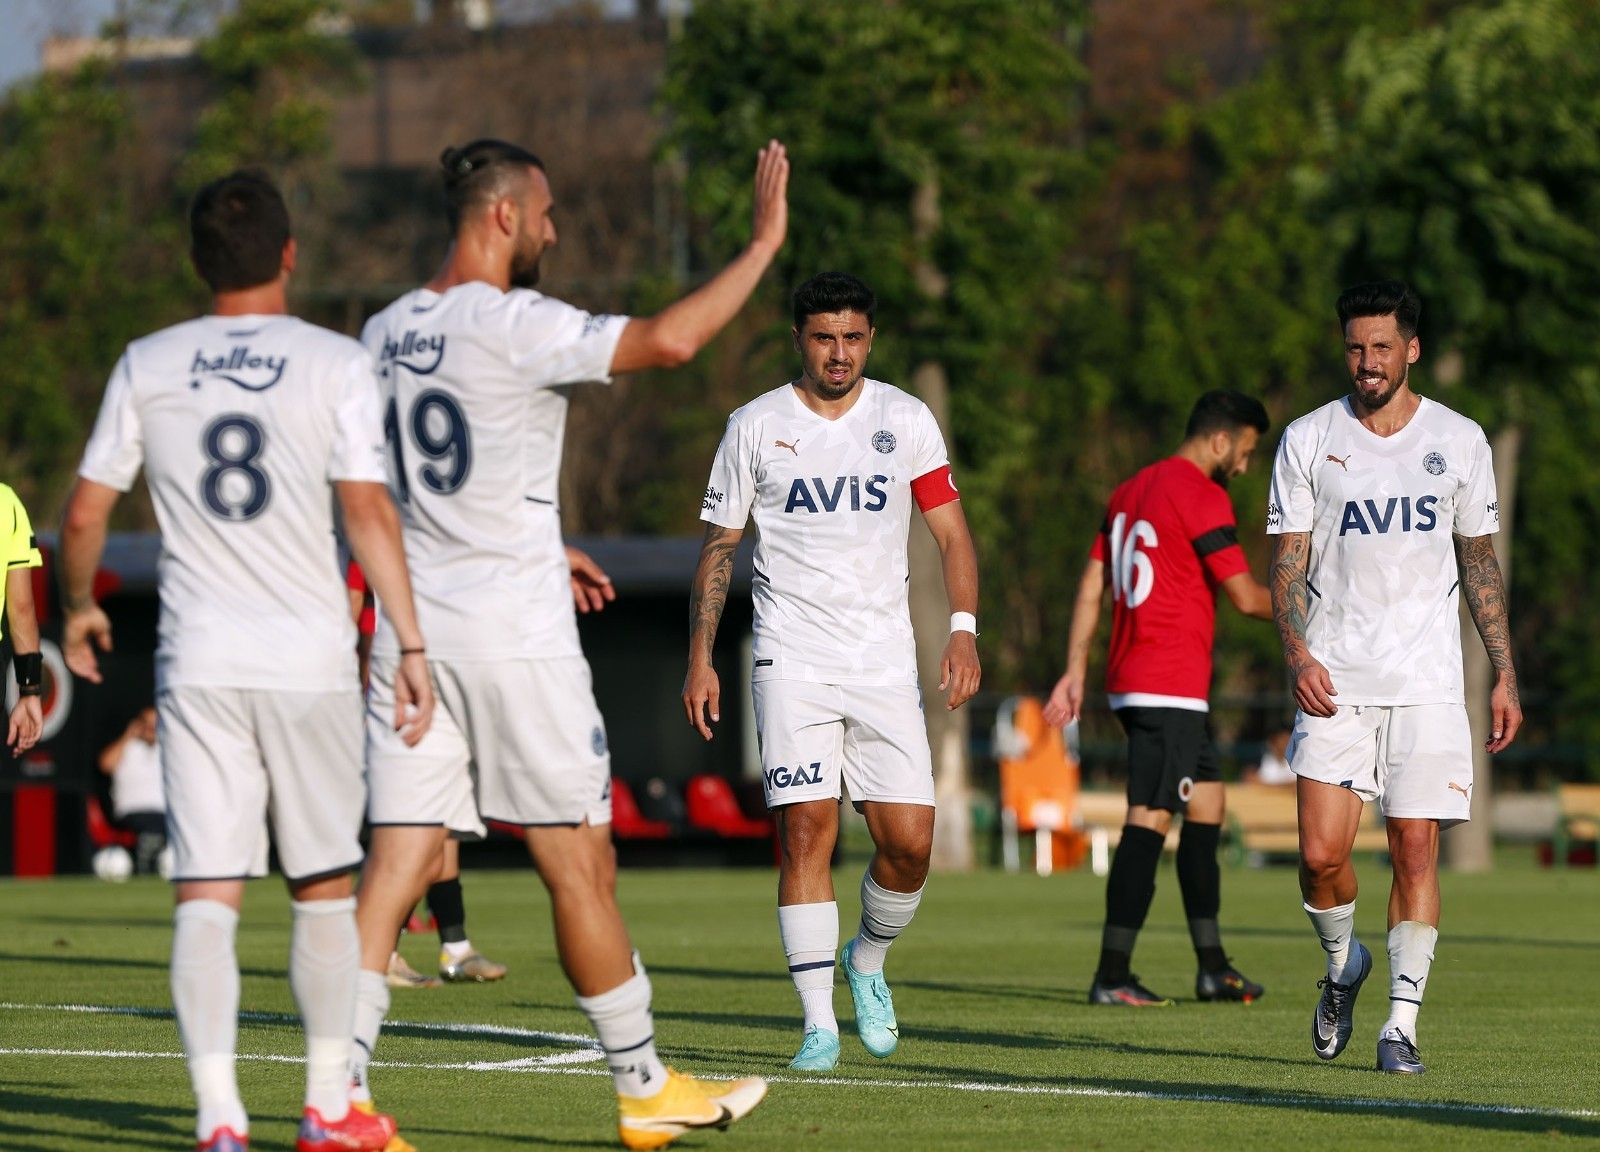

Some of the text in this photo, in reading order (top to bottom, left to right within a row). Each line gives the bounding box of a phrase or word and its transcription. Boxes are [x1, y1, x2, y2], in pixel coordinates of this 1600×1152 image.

[190, 345, 287, 392] halley
[199, 411, 273, 521] 8
[384, 387, 473, 503] 19
[785, 475, 888, 514] AVIS
[1339, 495, 1438, 537] AVIS
[1110, 512, 1158, 609] 16
